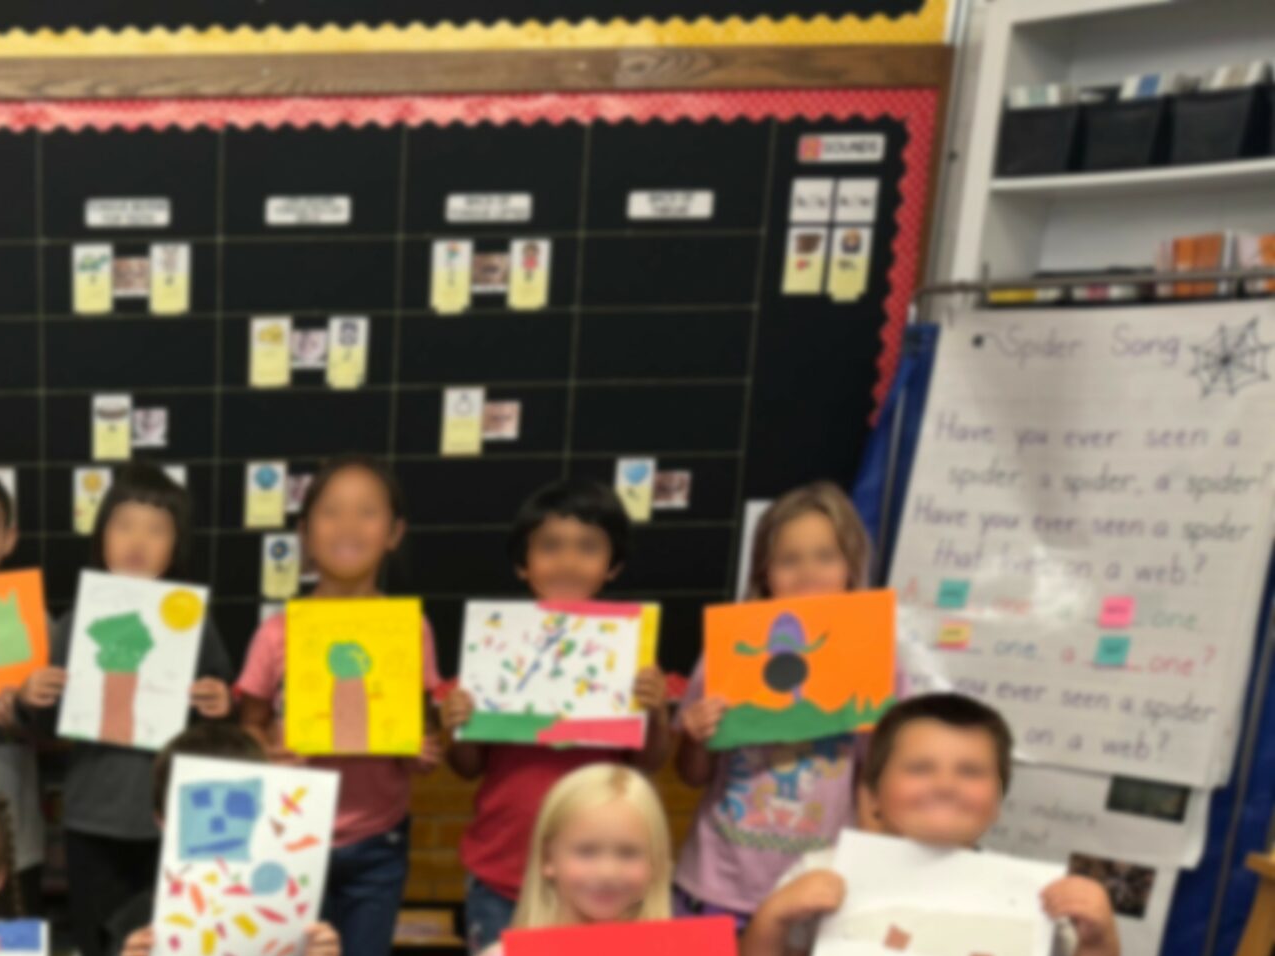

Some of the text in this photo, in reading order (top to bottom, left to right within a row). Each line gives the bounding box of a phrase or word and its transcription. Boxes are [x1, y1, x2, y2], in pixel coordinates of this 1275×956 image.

[1001, 322, 1181, 368] Spider Song
[935, 411, 994, 443] Have
[1063, 428, 1120, 447] ever
[1145, 428, 1209, 448] seen
[1225, 428, 1242, 447] a
[913, 493, 968, 526] Have
[1093, 517, 1145, 538] seen
